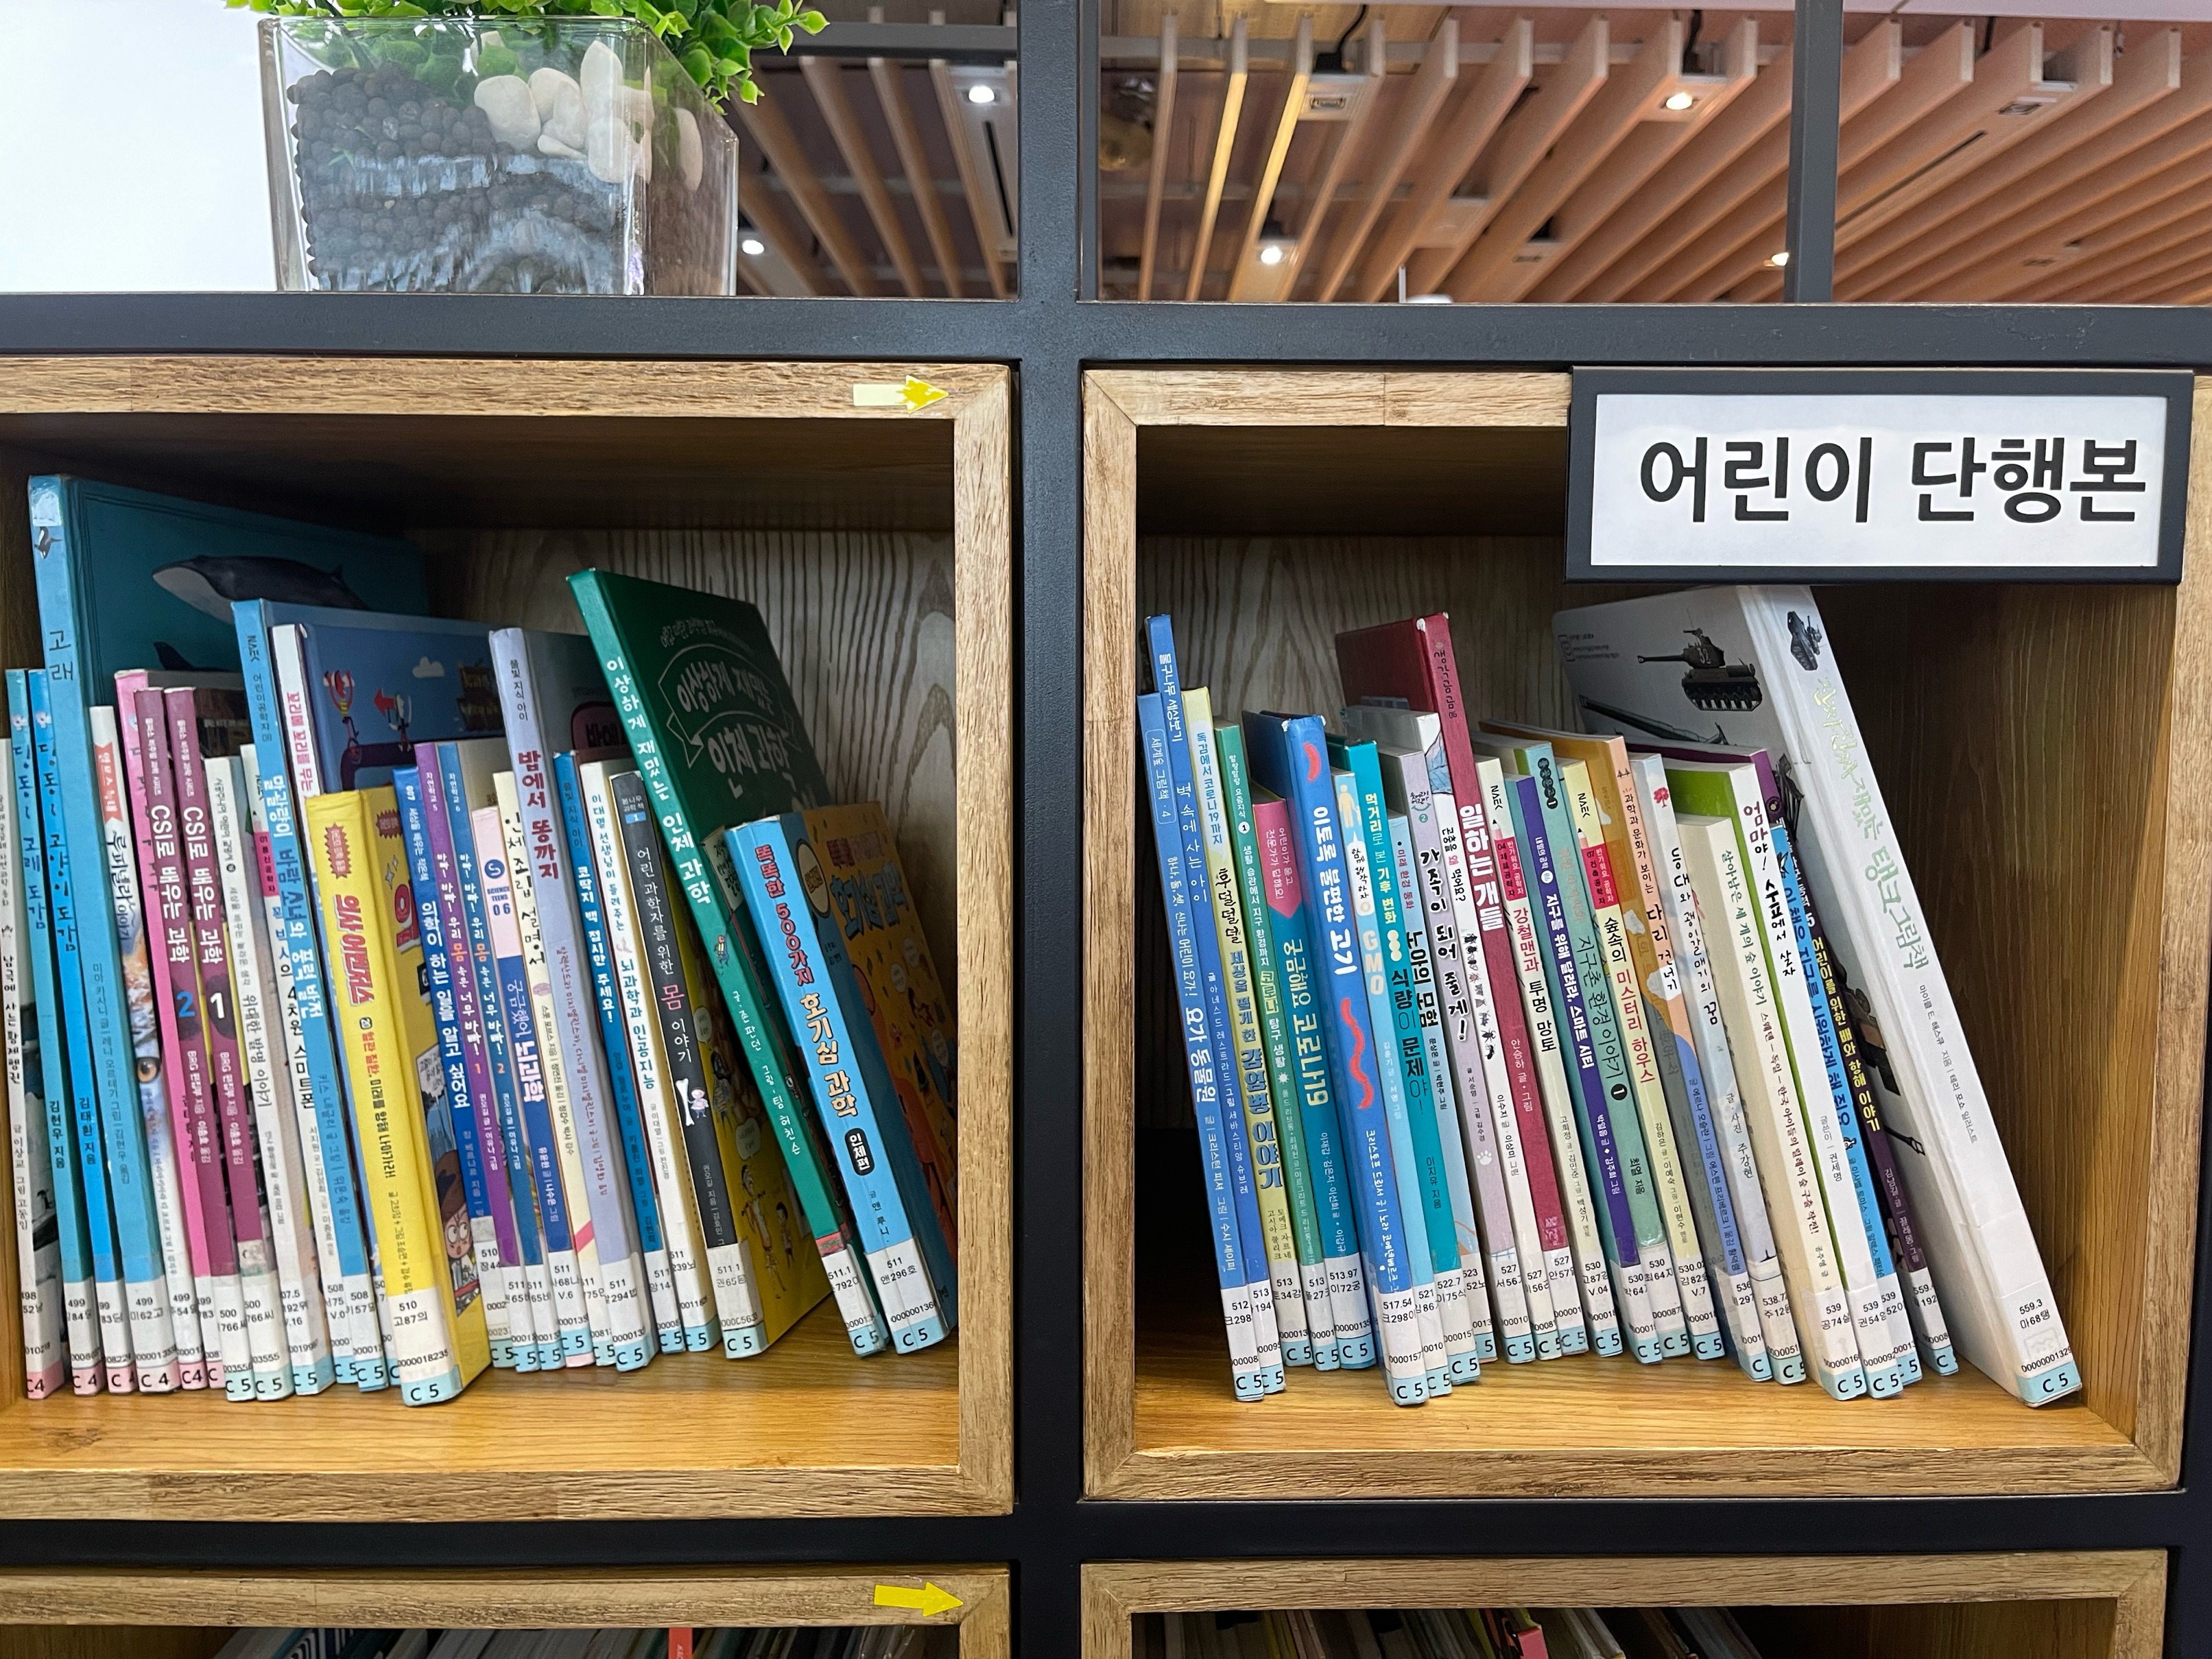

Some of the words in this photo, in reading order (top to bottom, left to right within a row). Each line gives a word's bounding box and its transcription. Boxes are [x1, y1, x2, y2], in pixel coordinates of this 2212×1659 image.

[1641, 437, 1872, 523] 어린이
[1911, 437, 2147, 523] 단행본
[49, 630, 74, 682] 고래
[1158, 653, 1178, 696] 물구나무
[287, 692, 304, 726] 꼬리에
[1166, 697, 1183, 743] 세상보기
[294, 730, 311, 765] 꼬리를
[1151, 737, 1165, 765] 세계숲
[1197, 732, 1213, 776] 독감에서
[299, 768, 313, 791] 무는
[518, 751, 547, 809] 밥에서
[606, 656, 647, 731] 이상하게
[637, 740, 669, 802] 재밌는
[662, 813, 695, 852] 인체
[679, 859, 713, 906] 과학
[1155, 766, 1169, 800] 그림책
[265, 775, 292, 837] 말괄량이
[1181, 804, 1196, 833] 속에
[1203, 777, 1223, 845] 코로나19까지
[1364, 793, 1384, 846] 먹거리로
[1853, 776, 1883, 841] 재밌는
[151, 805, 174, 859] CSI로
[183, 806, 209, 858] CSI로
[532, 820, 558, 879] 똥까지
[1314, 807, 1337, 862] 이토록
[1460, 804, 1493, 876] 일하는
[1624, 793, 1639, 826] 과학과
[1632, 829, 1646, 859] 문화가
[1641, 863, 1654, 894] 보이는
[23, 837, 40, 872] 고래
[276, 848, 301, 883] 바람
[638, 847, 655, 878] 어린
[1187, 839, 1202, 868] 사는
[1442, 827, 1457, 852] 곤충을
[1451, 868, 1466, 901] 먹어요?
[161, 866, 184, 920] 배우는
[193, 867, 217, 921] 배우는
[487, 886, 510, 894] SCIENCE
[578, 866, 594, 903] 코딱지
[599, 833, 615, 879] 선생님이
[609, 883, 624, 931] 들려주는
[1191, 874, 1207, 902] 아이
[1247, 868, 1260, 905] 습관에서
[1320, 866, 1346, 925] 불편한
[1378, 869, 1392, 892] 기후
[1420, 848, 1447, 911] 가족이
[1744, 801, 1768, 870] 엄마야!
[1780, 949, 1796, 977] 살자
[28, 885, 45, 929] 도감
[281, 890, 308, 938] 소녀와
[335, 894, 364, 931] 의사
[585, 911, 597, 922] 백
[645, 881, 667, 942] 과학자를
[1175, 912, 1187, 937] 신나는
[1215, 868, 1242, 944] 후덜덜덜
[1382, 898, 1397, 924] 변화
[1474, 881, 1504, 931] 개들
[1542, 893, 1565, 933] 지구를
[1647, 903, 1668, 942] 다리
[1864, 845, 1930, 970] 탱크그림책
[58, 907, 75, 951] 도감
[167, 925, 191, 963] 과학
[200, 925, 223, 963] 과학
[449, 916, 461, 940] 우리
[471, 916, 484, 940] 우리
[1436, 924, 1458, 960] 되어
[1513, 908, 1539, 973] 강철맨과
[1672, 847, 1691, 903] 등대와
[1684, 911, 1712, 992] 괭이갈매기의
[1704, 1001, 1718, 1025] 꿈
[1721, 849, 1744, 904] 살아남은
[1739, 923, 1754, 948] 개의
[1750, 966, 1767, 1005] 이야기
[292, 948, 317, 981] 풍력
[451, 943, 468, 962] 몸
[474, 943, 490, 962] 몸
[588, 930, 606, 966] 접시만
[1176, 938, 1191, 970] 어린이
[1331, 929, 1357, 975] 고기
[1363, 931, 1384, 994] GMO
[1406, 930, 1431, 985] 노아의
[1554, 934, 1571, 960] 위해
[342, 934, 374, 1004] 어벤저스
[431, 953, 449, 985] 하는
[754, 844, 786, 898] 똑똑한
[776, 902, 816, 986] 500가지
[800, 992, 839, 1065] 호기심
[824, 1069, 857, 1117] 과학
[1283, 940, 1312, 1007] 궁금해요
[1558, 961, 1578, 1003] 달려라,
[176, 991, 196, 1018] 2
[210, 992, 225, 1018] 1
[298, 985, 323, 1018] 발전
[436, 990, 454, 1021] 일을
[460, 992, 475, 1016] 너무
[484, 992, 498, 1016] 너무
[508, 979, 532, 1038] 궁금했어
[661, 985, 685, 1010] 몸
[1261, 971, 1279, 1014] 코로나
[1391, 968, 1416, 1029] 식량이
[1416, 992, 1439, 1027] 모험
[1444, 971, 1468, 1041] 줄게!
[1528, 980, 1547, 1014] 투명
[1578, 935, 1602, 989] 지구촌
[1591, 990, 1612, 1027] 환경
[1602, 1030, 1623, 1079] 이야기
[1604, 916, 1627, 963] 숲속의
[1616, 968, 1643, 1031] 미스터리
[1632, 1036, 1656, 1084] 하우스
[243, 994, 262, 1034] 위대한
[1184, 1007, 1210, 1042] 요가
[1269, 1018, 1281, 1040] 탐구
[1566, 1006, 1589, 1043] 스마트
[249, 1038, 265, 1063] 발명
[442, 1027, 462, 1057] 알고
[671, 1019, 692, 1064] 이야기
[1510, 1038, 1525, 1070] 안승하
[1536, 1021, 1556, 1053] 망토
[514, 1041, 545, 1103] 뇌과학
[633, 1025, 654, 1090] 인공지능
[1190, 1045, 1216, 1103] 동물원
[1273, 1045, 1285, 1068] 생활
[1292, 1013, 1329, 1106] 코로나19
[1402, 1036, 1428, 1114] 문제야!
[1578, 1044, 1595, 1070] 시티
[1829, 996, 1846, 1029] 위한
[1839, 1029, 1856, 1057] 배와
[1848, 1060, 1866, 1090] 항해
[1858, 1092, 1881, 1132] 이야기
[254, 1069, 272, 1107] 이야기
[449, 1063, 471, 1108] 싶어요
[1241, 1048, 1271, 1114] 감염병
[848, 1134, 870, 1171] 인체편
[1252, 1121, 1283, 1189] 이야기
[881, 1265, 917, 1285] 앤296호
[887, 1257, 903, 1269] 511
[1329, 1269, 1357, 1281] 513.97
[1585, 1261, 1601, 1272] 530
[173, 1293, 190, 1302] 499
[610, 1278, 626, 1289] 511
[1331, 1281, 1360, 1293] 이72궁
[1438, 1277, 1461, 1290] 522.7
[1588, 1285, 1608, 1297] V.04
[394, 1311, 427, 1326] 고87의
[399, 1300, 418, 1311] 510
[1383, 1298, 1412, 1311] 517.54
[1826, 1303, 1842, 1314] 539
[2020, 1299, 2043, 1315] 559.3
[2020, 1309, 2050, 1329] 마68탱
[2043, 1378, 2054, 1393] C
[2059, 1372, 2068, 1387] 5
